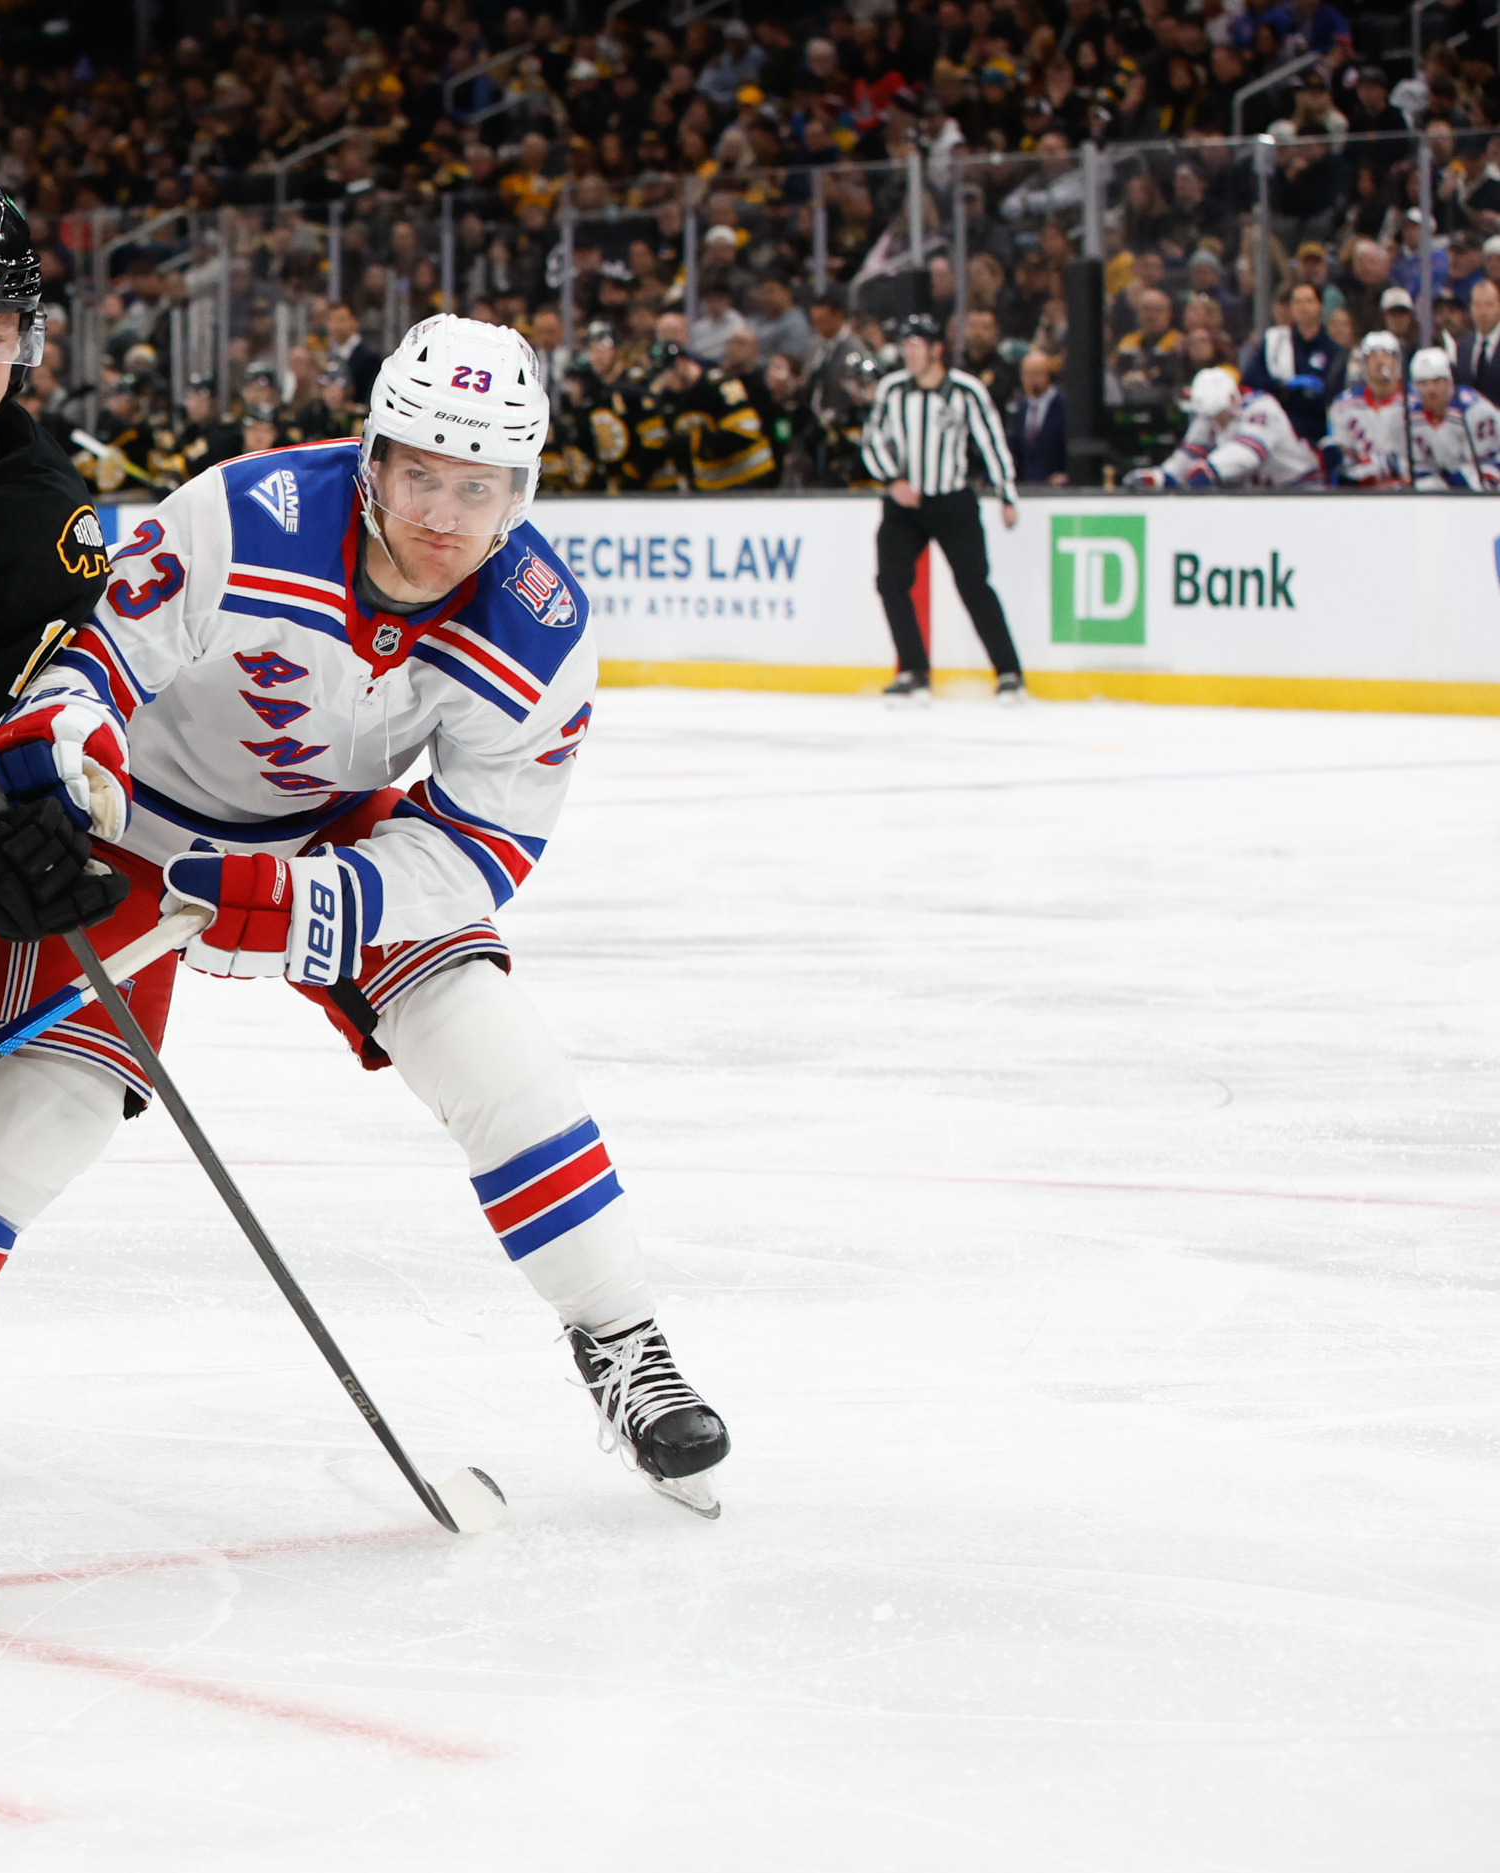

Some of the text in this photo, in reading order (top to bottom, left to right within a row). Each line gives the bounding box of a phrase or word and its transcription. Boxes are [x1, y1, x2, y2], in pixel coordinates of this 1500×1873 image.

[451, 365, 493, 394] 23
[434, 411, 491, 430] BAUER
[281, 470, 299, 533] GAME
[106, 518, 186, 621] 23
[515, 556, 560, 614] 100
[550, 536, 801, 580] ECHES LAW
[1057, 536, 1296, 621] TD Bank
[8, 619, 78, 699] 1
[233, 651, 338, 798] RANG
[345, 1378, 376, 1423] CCM
